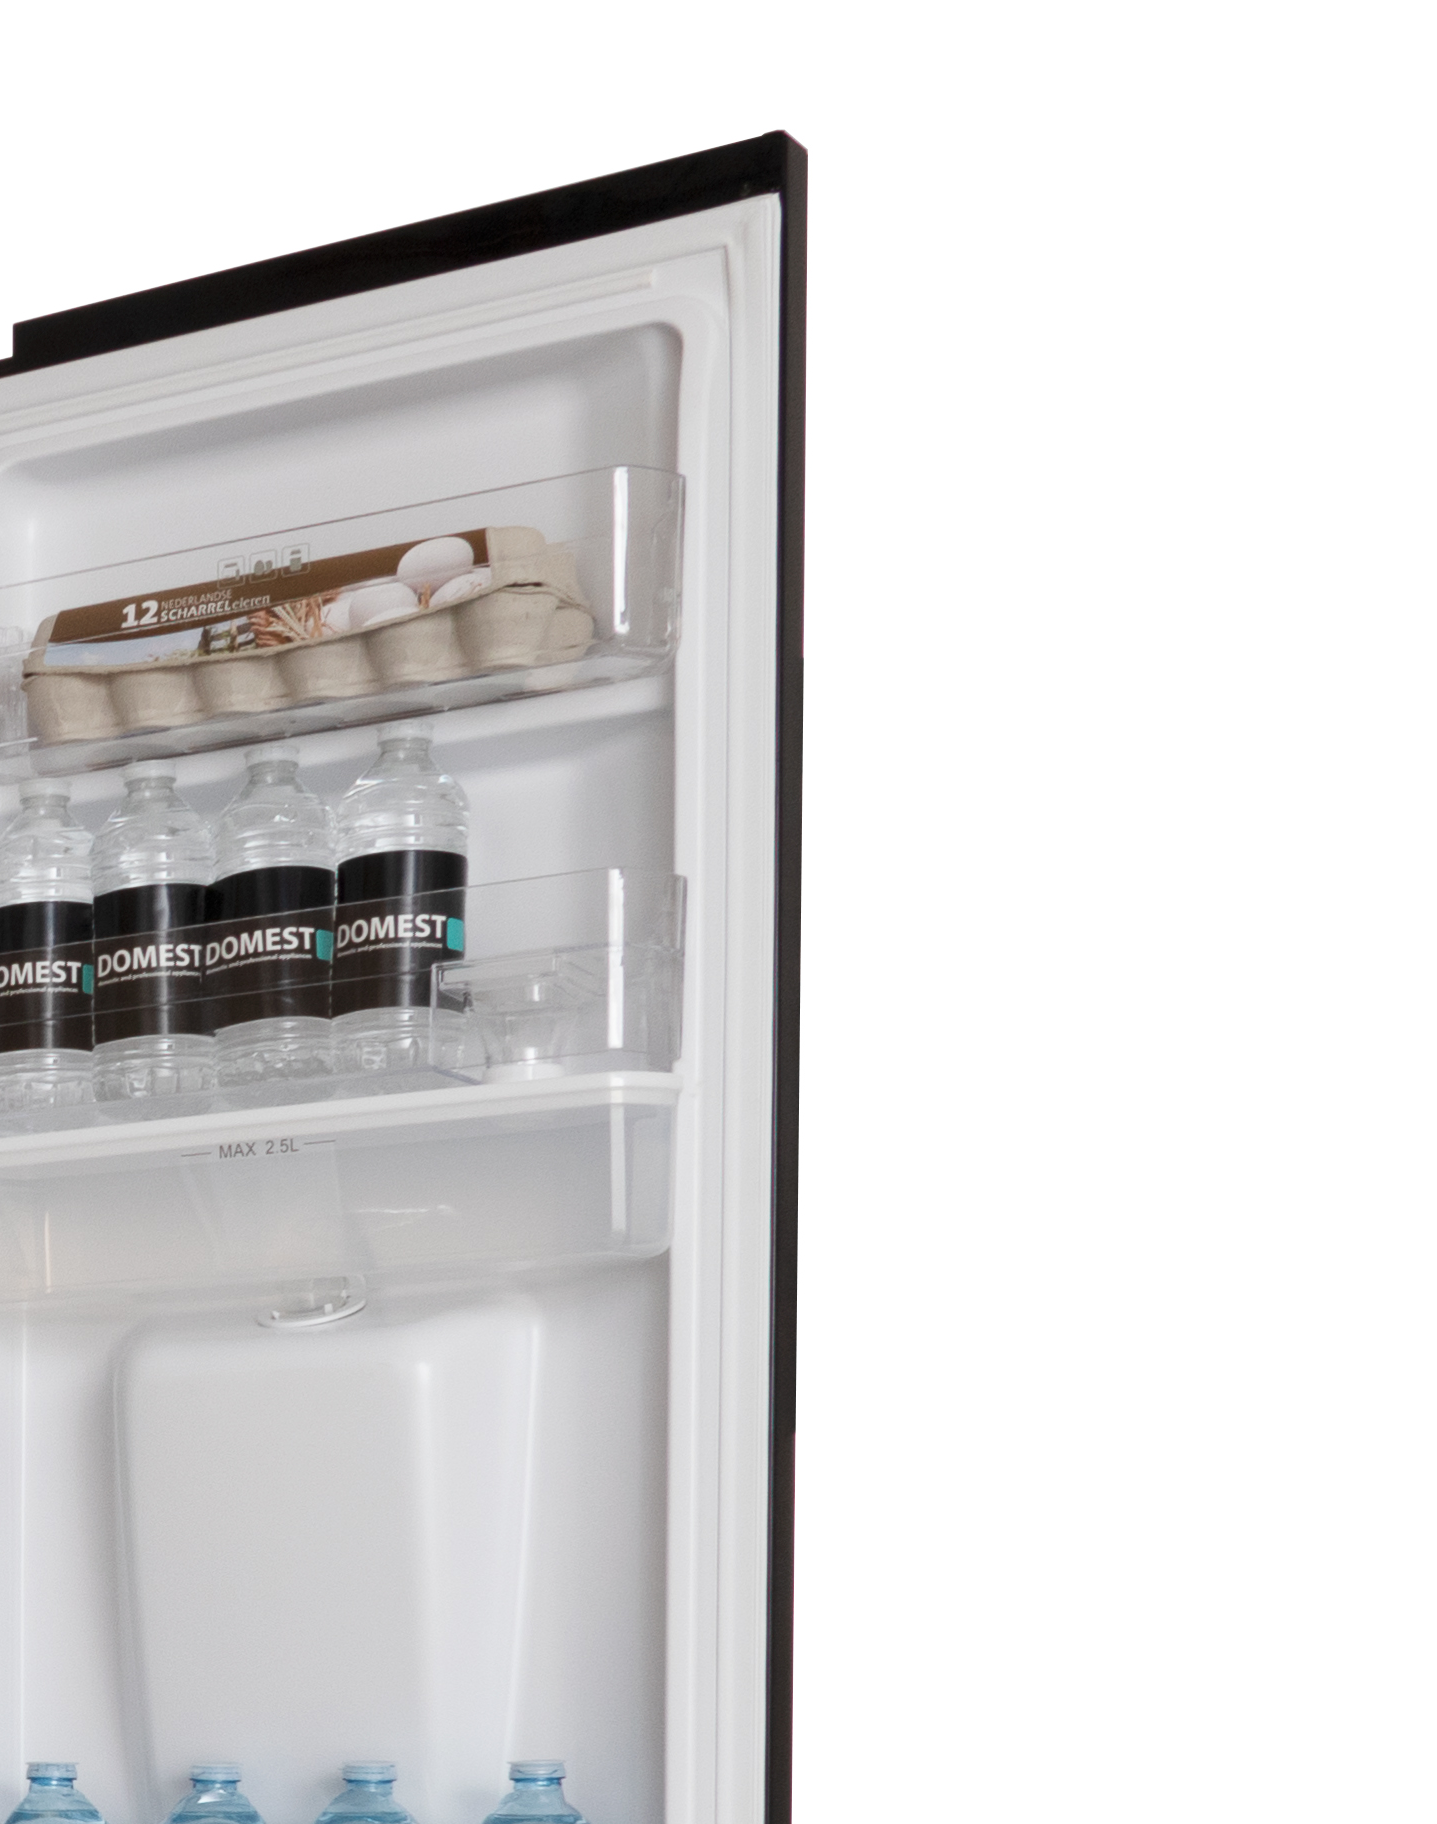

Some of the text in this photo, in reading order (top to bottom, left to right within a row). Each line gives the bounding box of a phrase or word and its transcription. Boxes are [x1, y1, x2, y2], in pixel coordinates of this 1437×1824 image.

[120, 600, 159, 629] 12
[161, 588, 233, 610] NEDERLANDSE
[205, 926, 315, 966] DOMEST
[337, 914, 447, 949] DOMEST
[97, 944, 203, 978] DOMEST
[218, 1137, 299, 1159] MAX 2.5L
